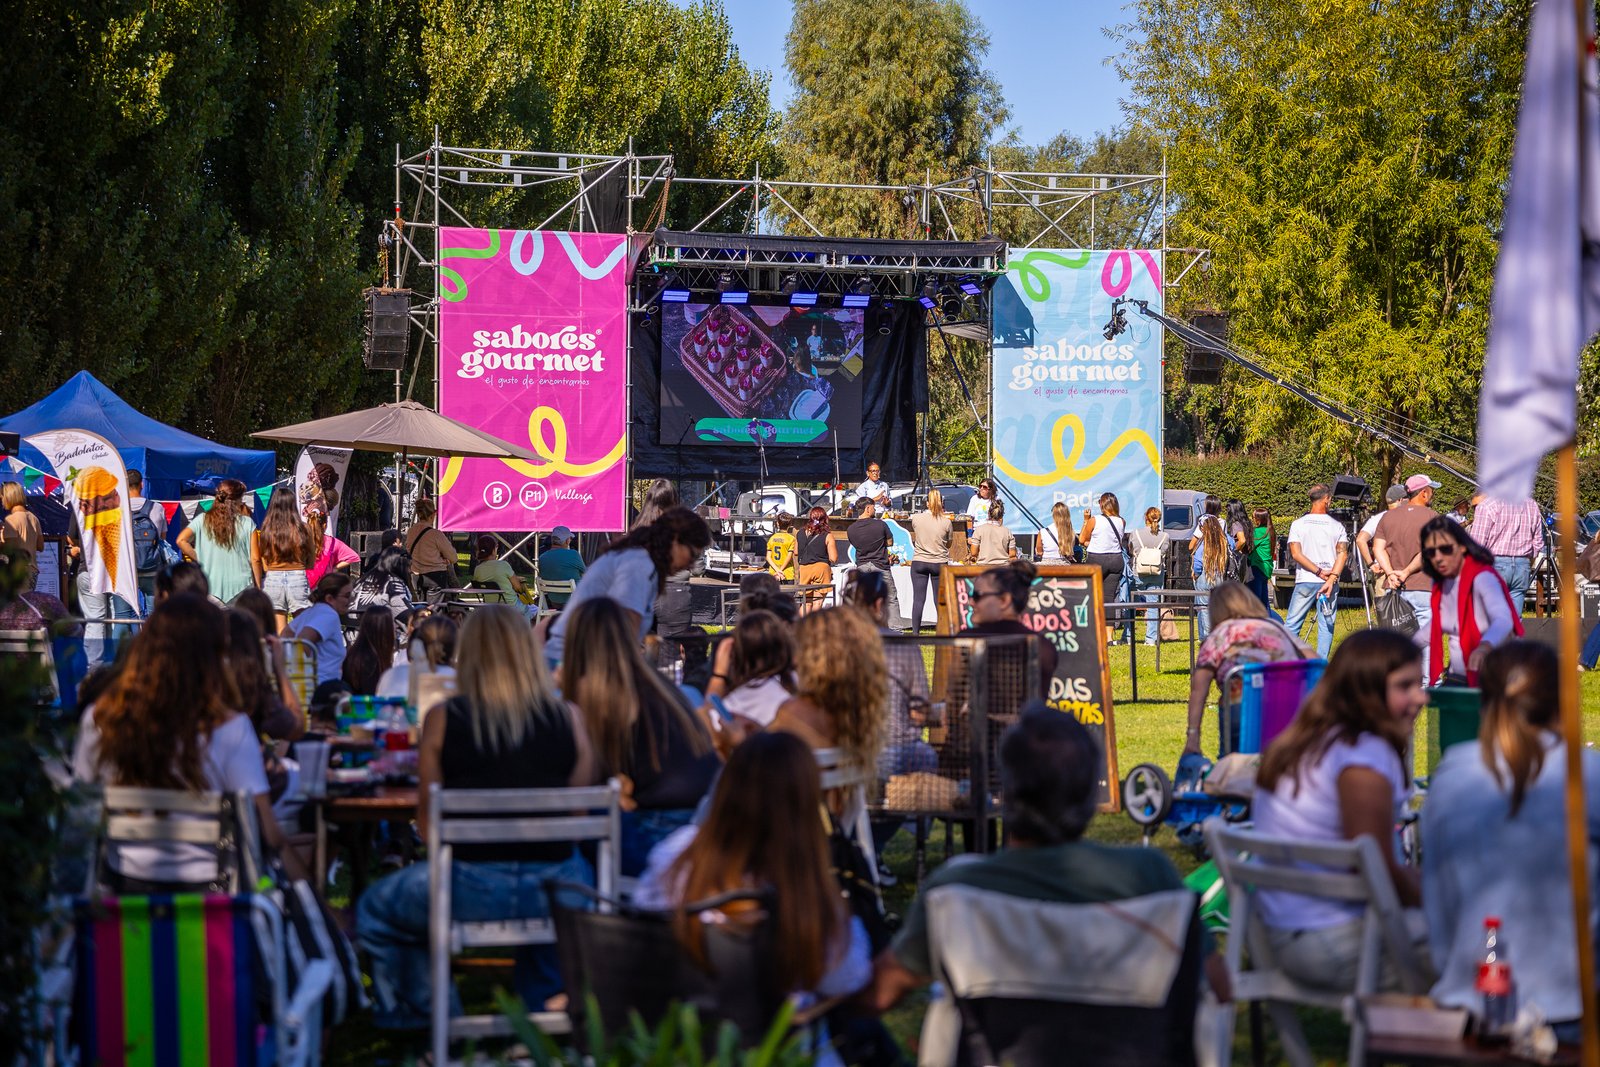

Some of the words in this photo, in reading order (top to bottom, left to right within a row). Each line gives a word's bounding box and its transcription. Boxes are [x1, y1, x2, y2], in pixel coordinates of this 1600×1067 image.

[472, 324, 597, 351] sabores
[1022, 337, 1134, 362] sabores
[456, 349, 606, 379] gourmet
[1008, 360, 1143, 391] gourmet
[484, 374, 494, 386] el
[497, 376, 519, 388] gusto
[522, 374, 535, 389] de
[1033, 386, 1042, 397] el
[1045, 386, 1064, 399] gusto
[1067, 385, 1079, 399] de
[54, 441, 105, 469] Badolatos
[525, 490, 542, 502] P11
[1053, 490, 1102, 508] Rada
[774, 545, 782, 561] 5
[1027, 588, 1067, 612] GOS
[1022, 608, 1073, 632] ADOS
[1048, 676, 1093, 702] DAS
